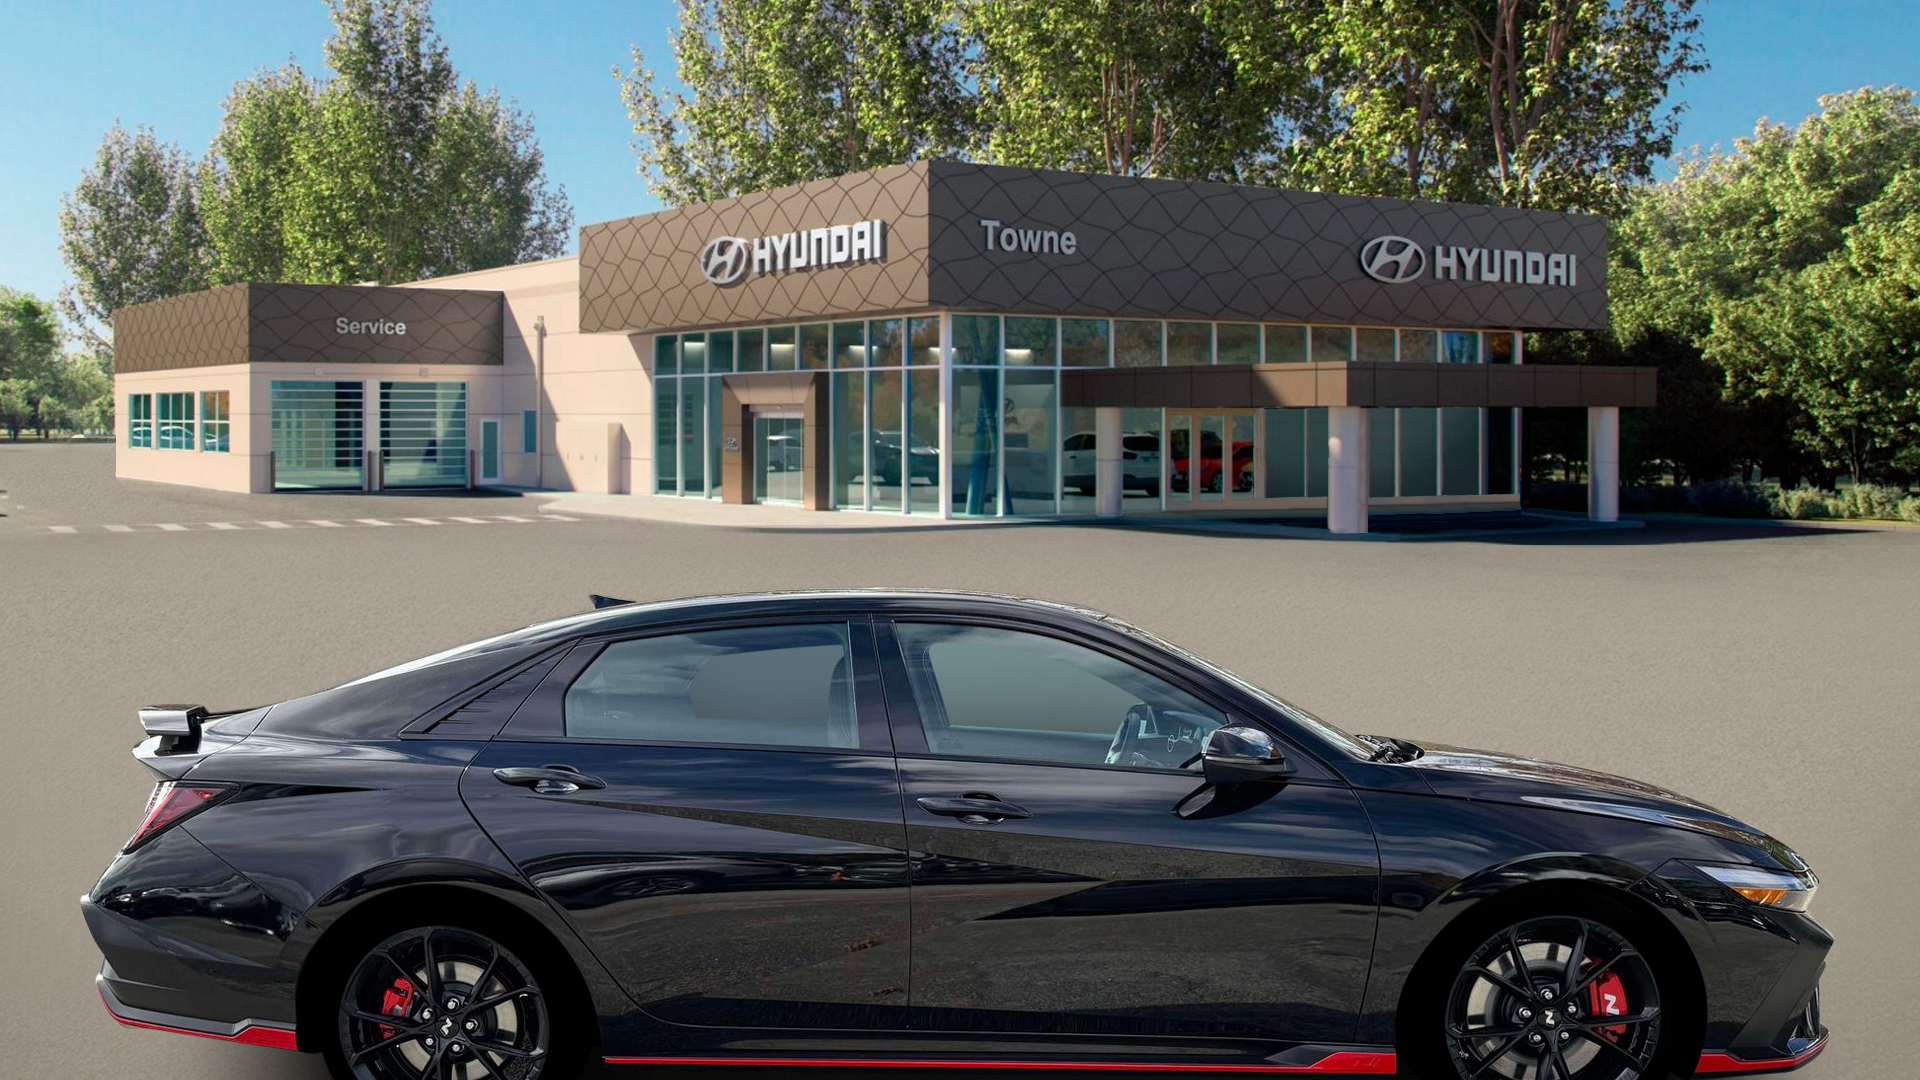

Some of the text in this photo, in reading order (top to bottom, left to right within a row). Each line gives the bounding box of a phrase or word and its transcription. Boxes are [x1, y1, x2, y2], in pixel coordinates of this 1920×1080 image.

[753, 219, 883, 274] HYUNDAI
[980, 219, 1077, 255] Towne
[1433, 245, 1577, 287] HYUNDAI
[335, 317, 407, 335] Service
